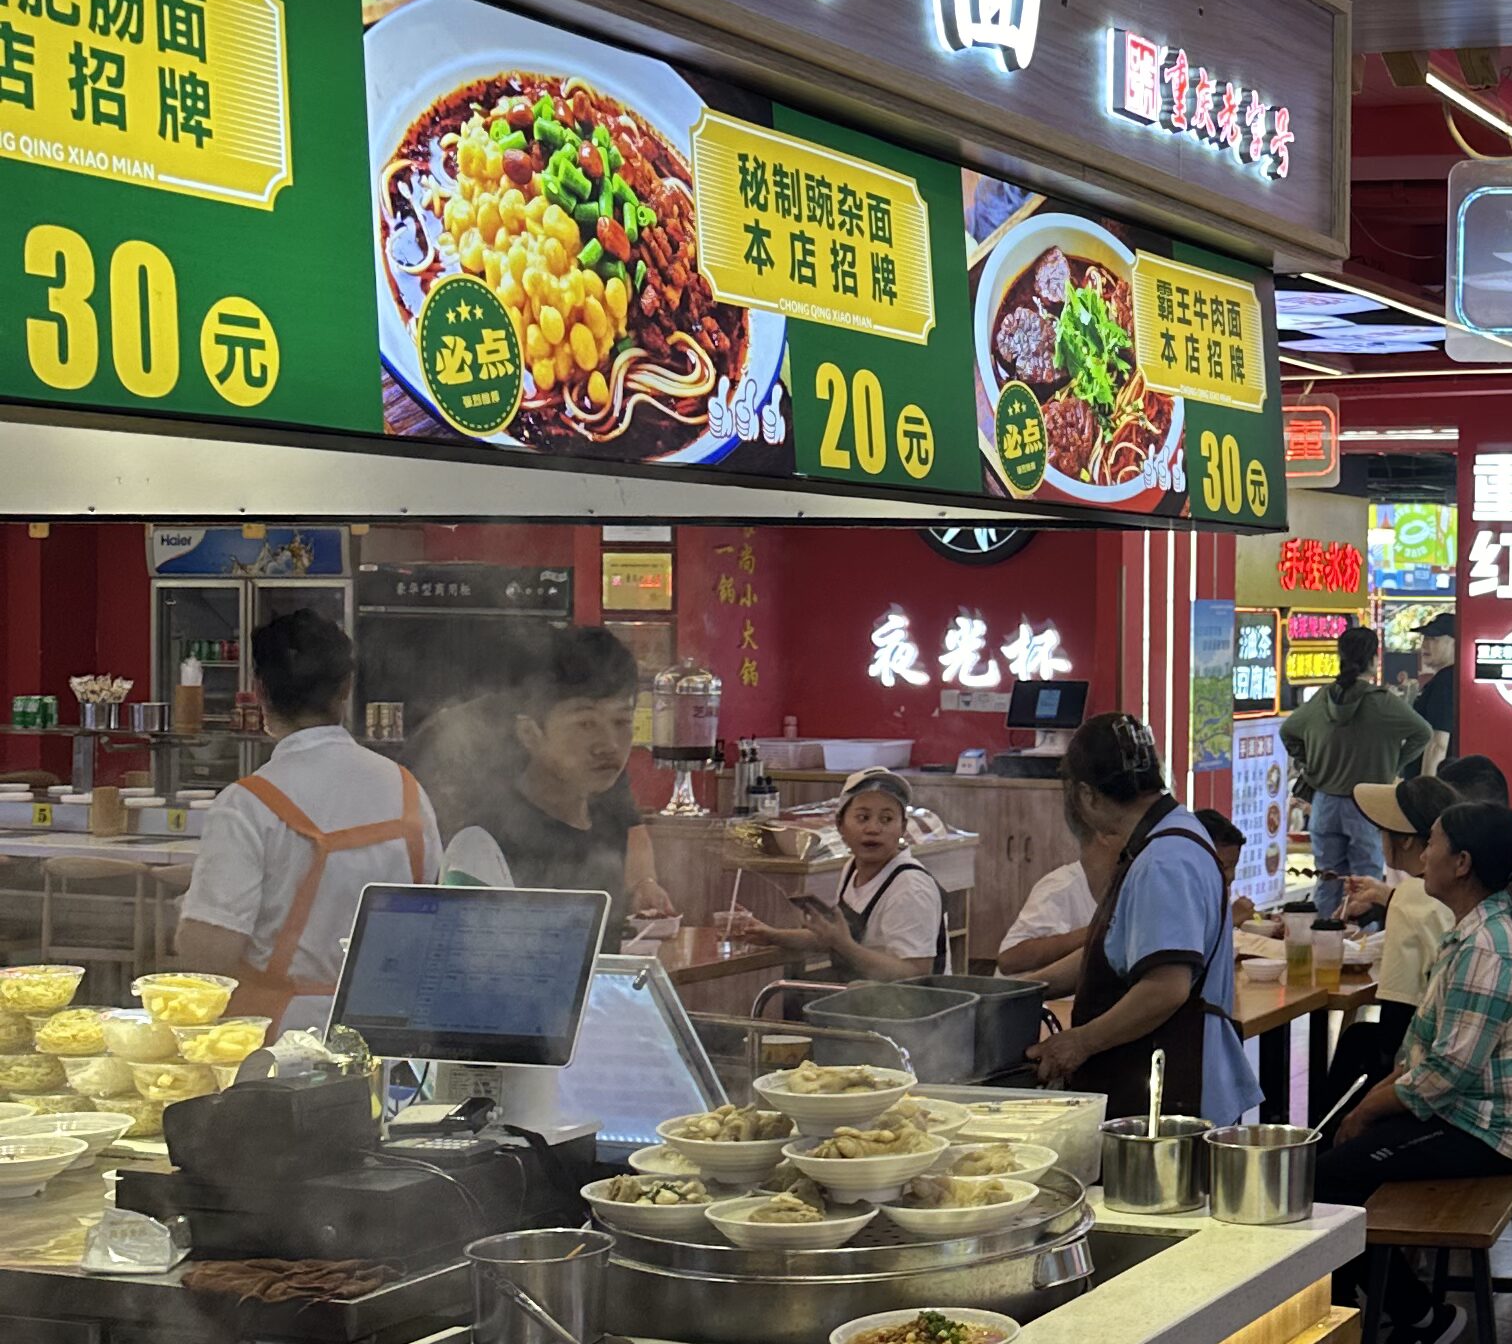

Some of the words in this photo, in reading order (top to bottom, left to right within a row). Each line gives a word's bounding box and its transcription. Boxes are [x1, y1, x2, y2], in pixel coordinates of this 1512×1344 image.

[19, 134, 64, 162] QING
[68, 145, 109, 172] XIAO
[112, 154, 155, 181] MIAN
[737, 152, 894, 249] 秘制豌杂面
[743, 220, 898, 306] 本店招牌
[778, 297, 810, 316] CHONG
[811, 304, 832, 321] QING
[832, 308, 853, 325] XIAO
[853, 312, 873, 329] MIAN
[1156, 278, 1243, 341] 霸王牛肉面
[435, 328, 515, 385] 必点
[1160, 327, 1245, 385] 本店招牌
[1003, 419, 1043, 460] 必点
[161, 534, 192, 547] Haier
[868, 613, 1073, 687] 夜光杯
[38, 808, 47, 823] 5
